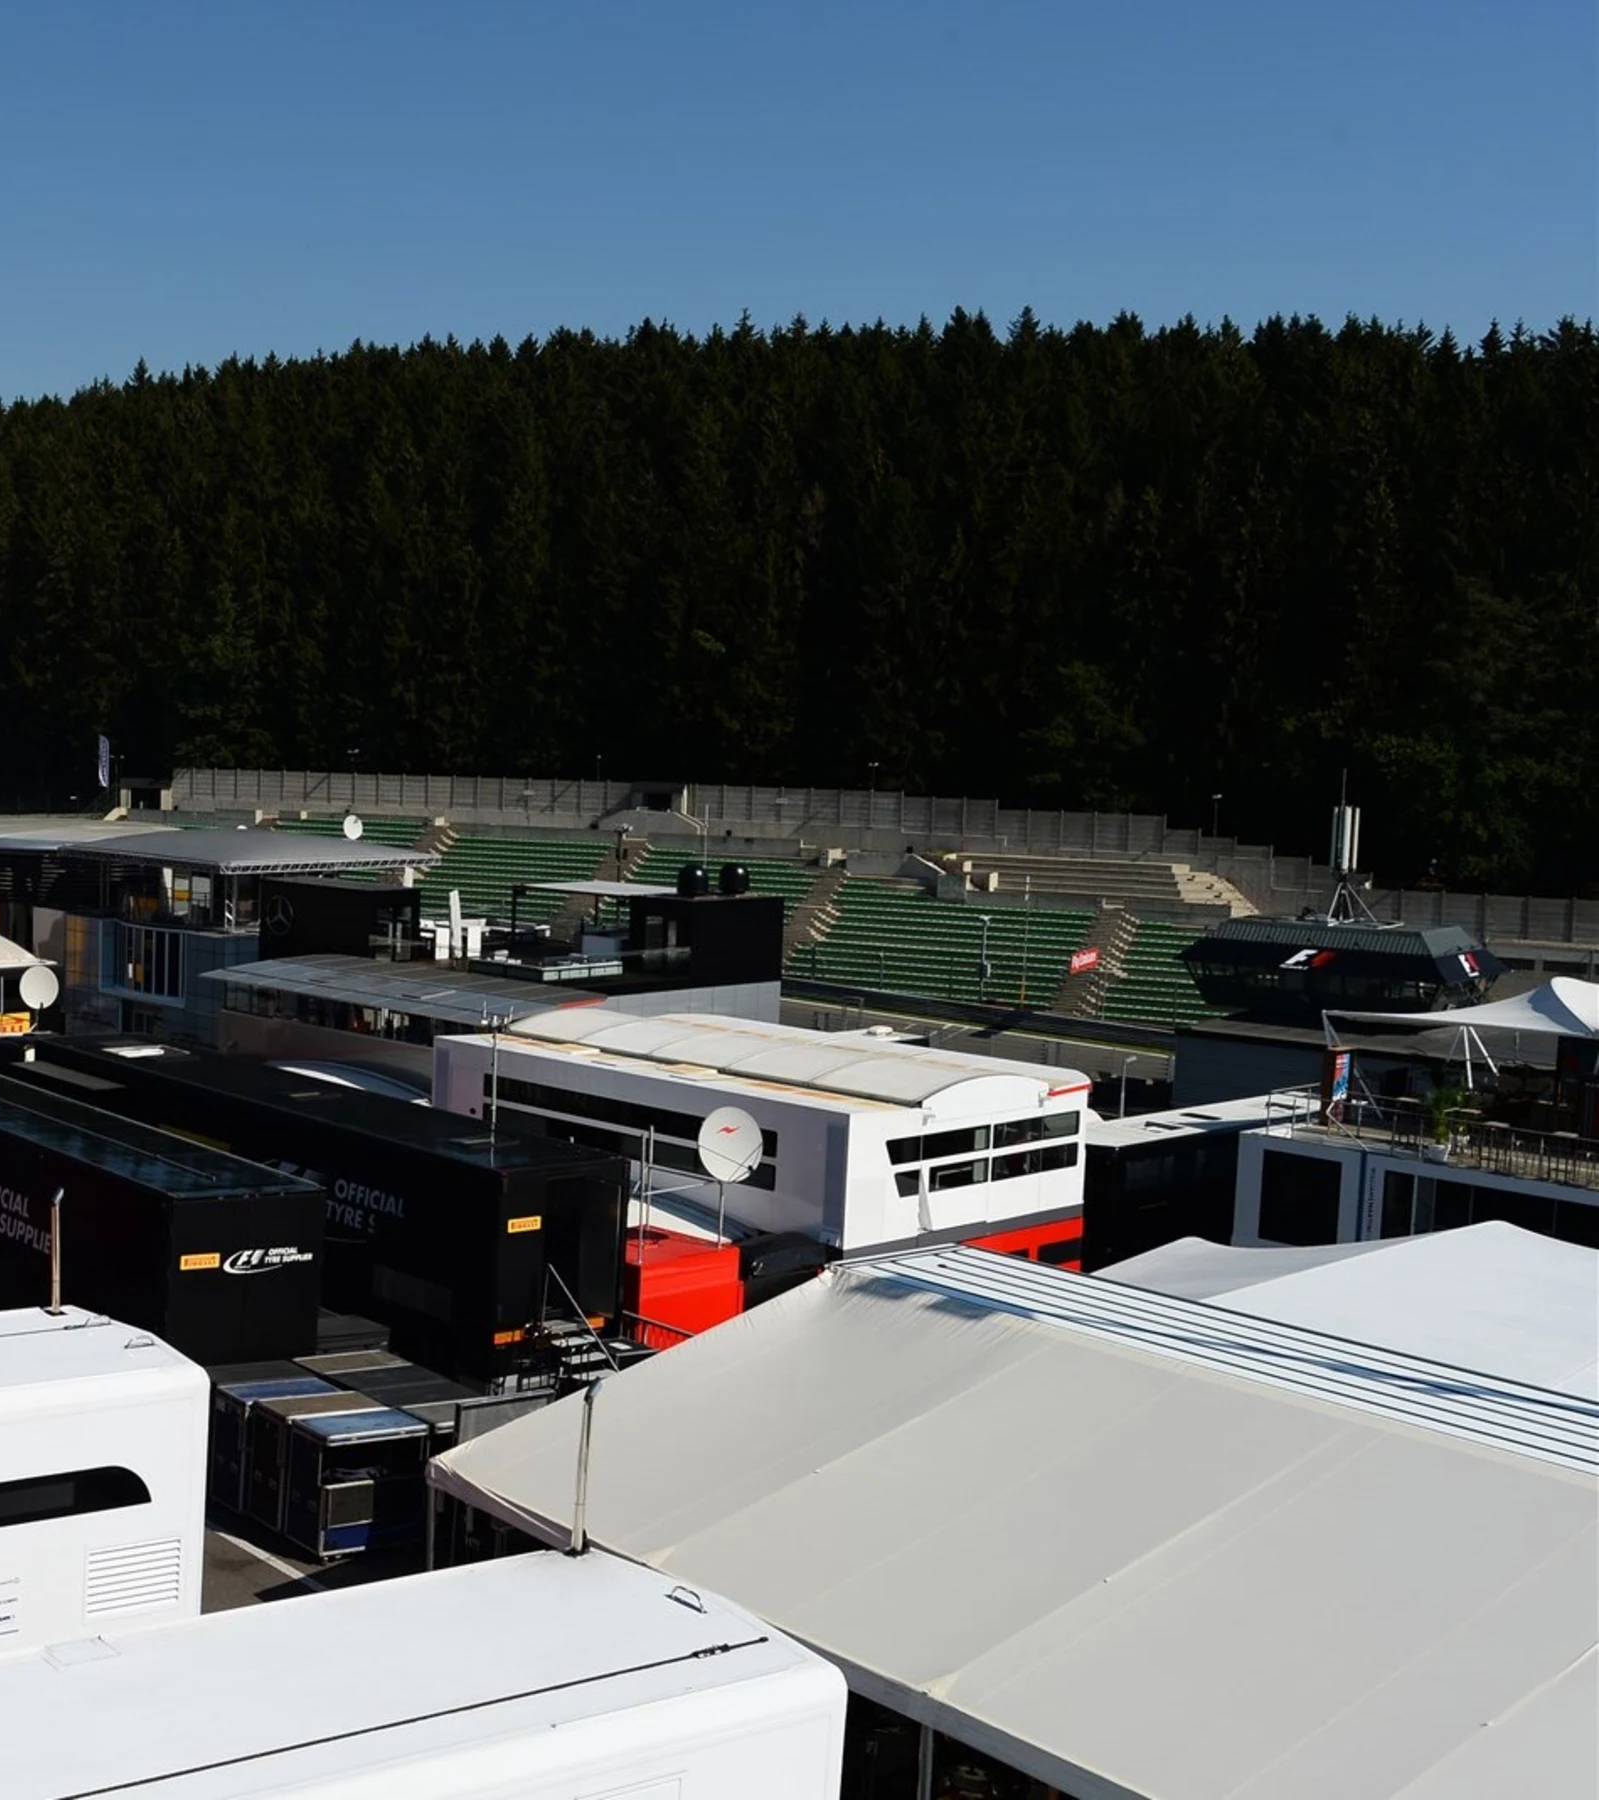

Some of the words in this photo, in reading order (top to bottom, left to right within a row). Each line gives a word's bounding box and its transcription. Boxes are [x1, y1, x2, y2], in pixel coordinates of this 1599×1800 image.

[334, 1178, 404, 1218] OFFICIAL
[326, 1200, 363, 1229] TYRE
[265, 1255, 281, 1264] TYRE
[282, 1252, 313, 1264] SUPPLIER
[268, 1246, 298, 1256] OFFICIAL
